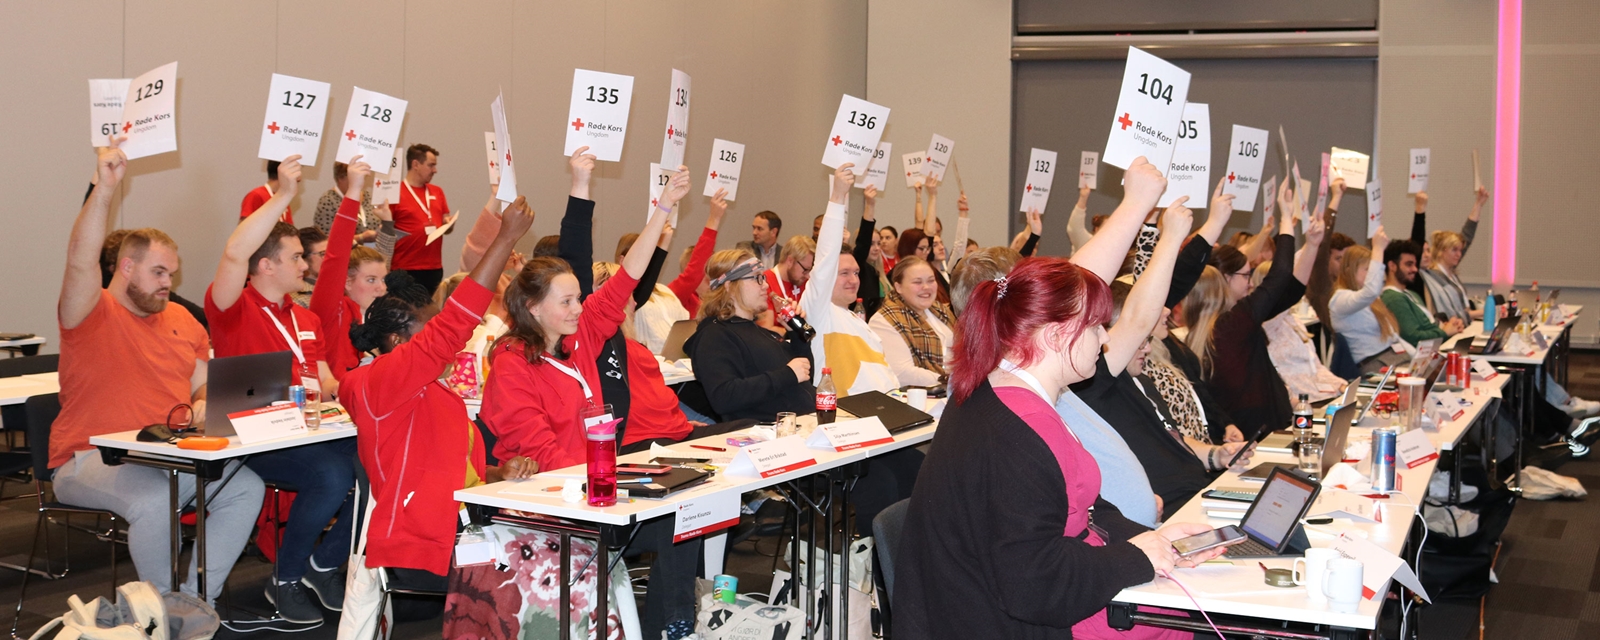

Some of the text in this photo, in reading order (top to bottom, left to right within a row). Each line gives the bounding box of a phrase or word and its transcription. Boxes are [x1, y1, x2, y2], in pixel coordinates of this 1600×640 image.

[134, 79, 164, 103] 129
[586, 86, 619, 104] 135
[1138, 73, 1173, 105] 104
[282, 90, 316, 109] 127
[360, 103, 392, 122] 128
[134, 113, 170, 126] Røde Kors
[848, 110, 877, 130] 136
[101, 123, 122, 135] 19
[283, 126, 318, 137] Røde Kors
[588, 122, 622, 132] Røde Kors
[1136, 121, 1172, 145] Røde Kors
[1178, 120, 1198, 139] 05
[282, 134, 305, 142] Ungdom
[586, 130, 609, 138] Ungdom
[1134, 133, 1158, 148] Ungdom
[359, 134, 392, 148] Røde Kors
[845, 141, 873, 154] Røde Kors
[842, 148, 861, 156] Ungdom
[873, 149, 884, 159] 09
[934, 142, 948, 154] 120
[1238, 141, 1259, 158] 106
[719, 150, 737, 163] 126
[908, 157, 922, 165] 139
[1035, 160, 1050, 173] 132
[1171, 163, 1206, 172] Røde Kors
[658, 174, 671, 186] 12
[1171, 173, 1193, 181] Ungdom
